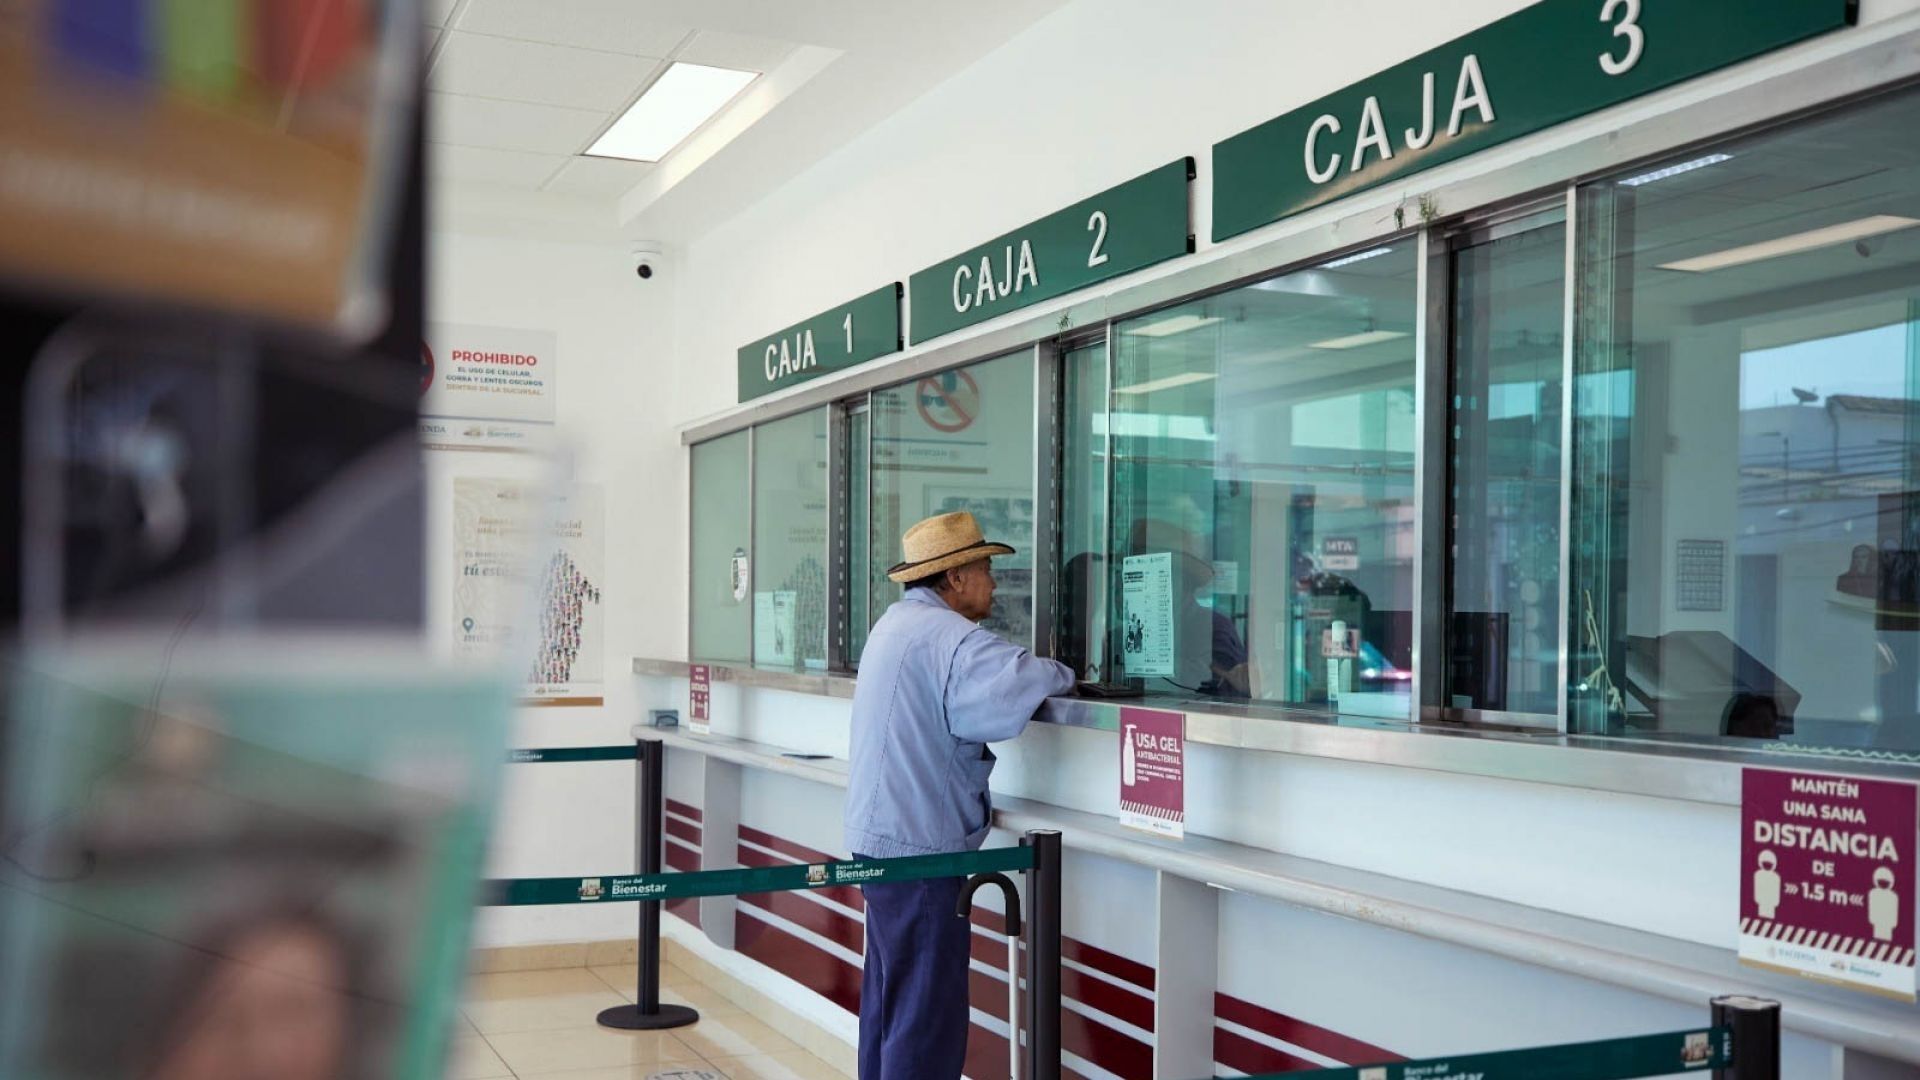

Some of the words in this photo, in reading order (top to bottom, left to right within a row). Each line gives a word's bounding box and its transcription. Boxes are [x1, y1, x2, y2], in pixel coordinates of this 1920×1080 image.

[1304, 54, 1496, 184] CAJA
[1598, 0, 1645, 76] 3
[952, 239, 1039, 313] CAJA
[1087, 210, 1109, 267] 2
[764, 328, 817, 382] CAJA
[842, 312, 854, 354] 1
[452, 350, 537, 366] PROHIBIDO
[446, 374, 472, 382] GORRA
[508, 378, 543, 387] OSCUROS
[1136, 733, 1158, 750] USA
[1160, 736, 1181, 753] GEL
[1137, 751, 1181, 764] ANTIBACTERIAL
[1791, 777, 1859, 798] MANTÉN
[1783, 800, 1818, 819] UNA
[1821, 805, 1866, 824] SANA
[1754, 820, 1899, 862] DISTANCIA
[835, 868, 885, 879] Bienestar
[1812, 860, 1835, 877] DE
[612, 884, 667, 895] Bienestar
[1800, 881, 1825, 901] 1.5
[1829, 889, 1848, 905] m
[1404, 1066, 1432, 1075] Banco
[1434, 1063, 1449, 1073] del
